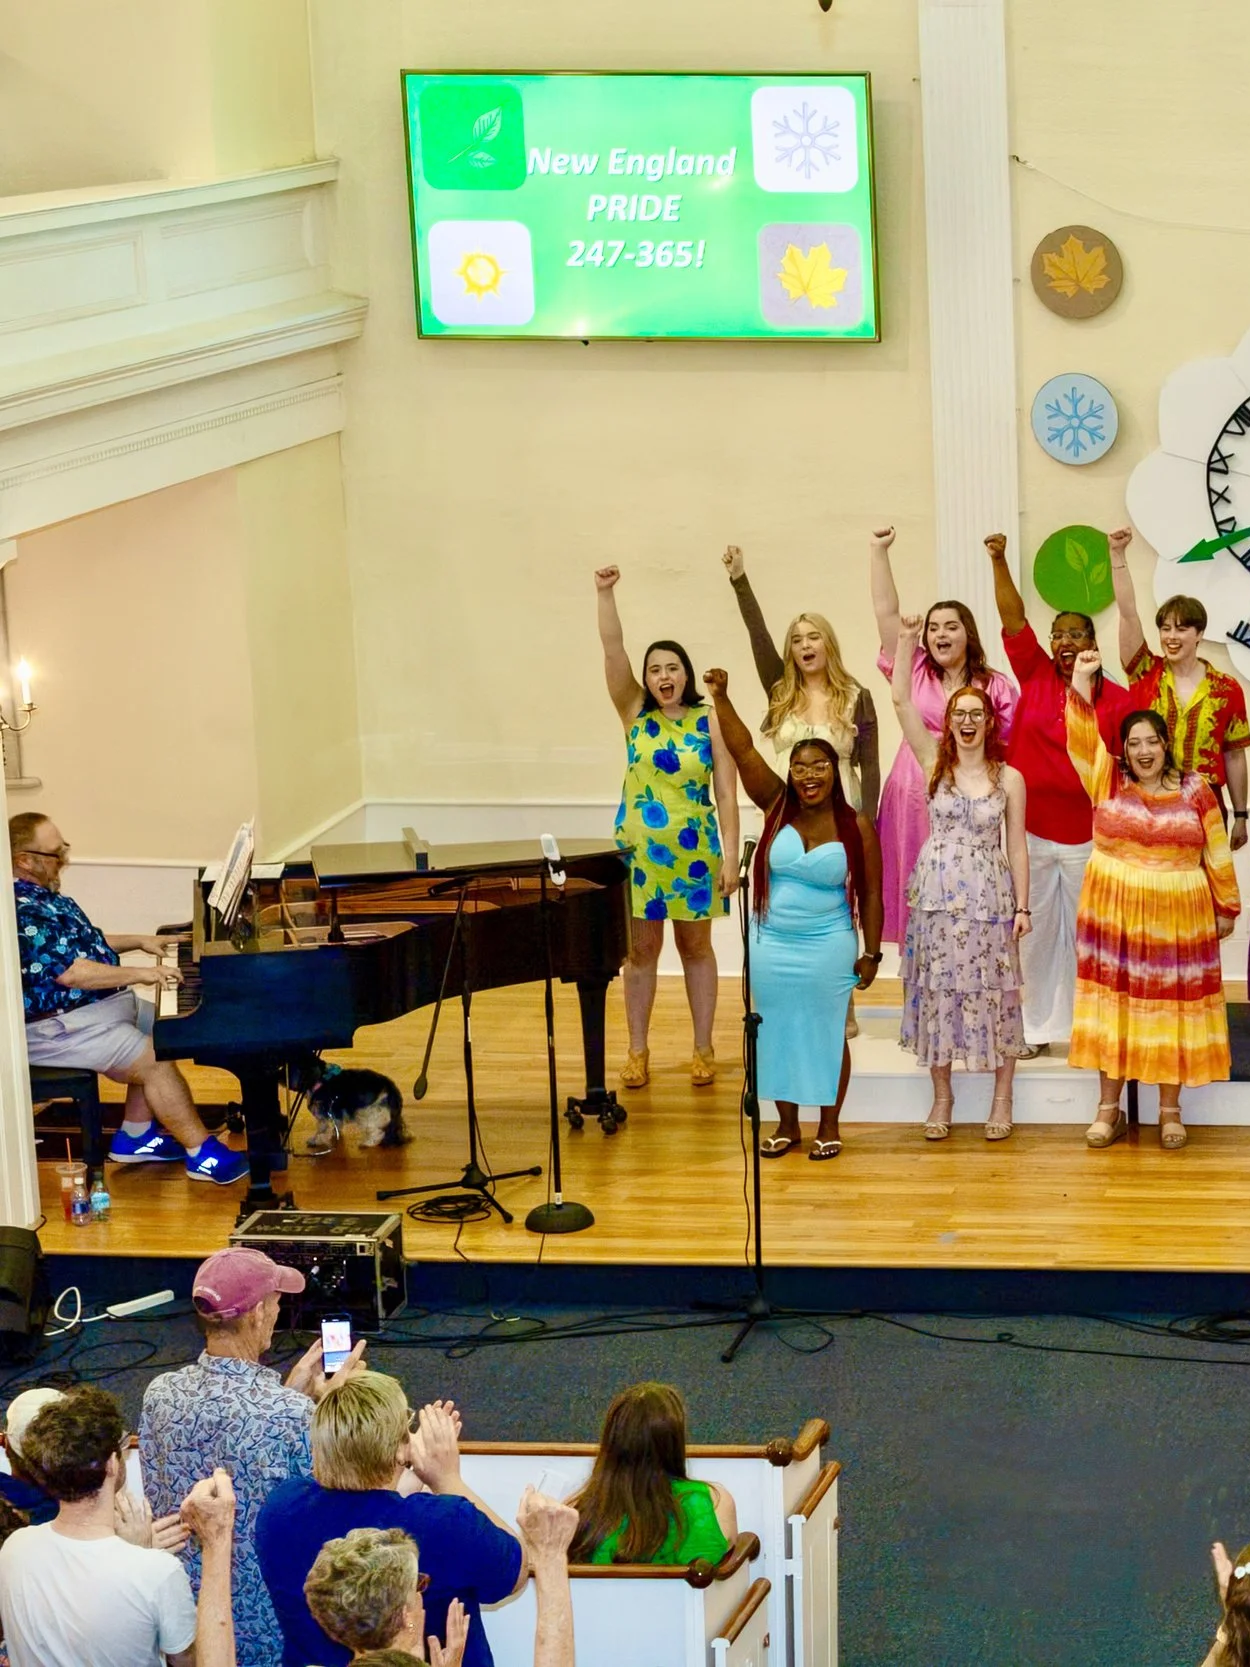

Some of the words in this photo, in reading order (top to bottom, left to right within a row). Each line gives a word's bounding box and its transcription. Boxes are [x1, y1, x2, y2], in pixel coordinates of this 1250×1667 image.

[527, 148, 599, 176] New
[608, 147, 738, 182] England
[587, 195, 684, 223] PRIDE
[566, 240, 707, 269] 247-365!
